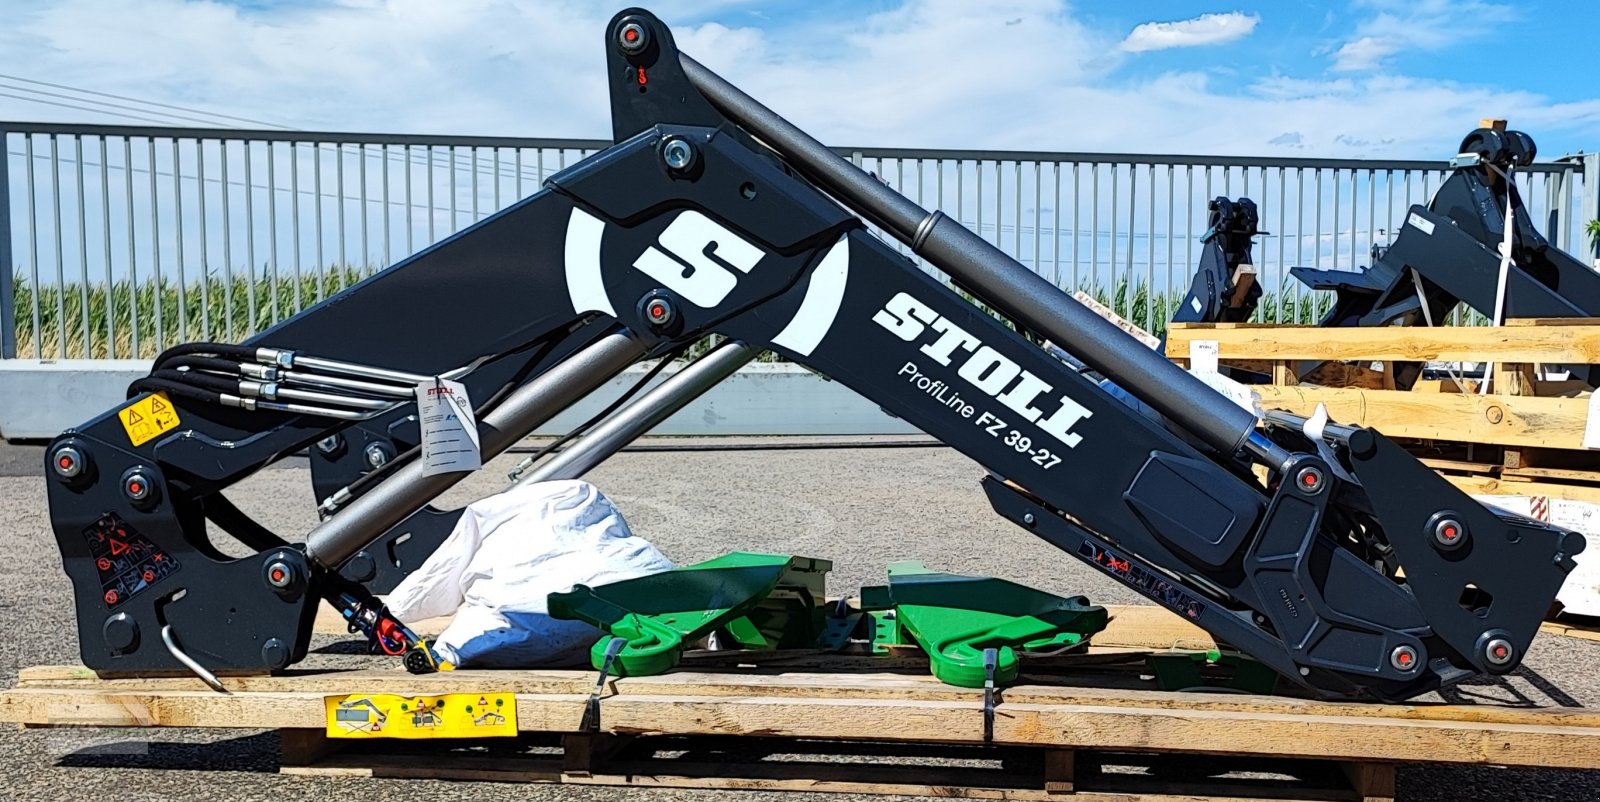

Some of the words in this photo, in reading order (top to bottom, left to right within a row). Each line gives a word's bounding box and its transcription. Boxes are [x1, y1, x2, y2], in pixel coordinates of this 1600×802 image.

[632, 210, 766, 308] S
[872, 292, 1094, 448] STOLL
[897, 361, 975, 419] ProfiLine
[975, 411, 1008, 437] FZ
[1004, 429, 1063, 470] 39-27
